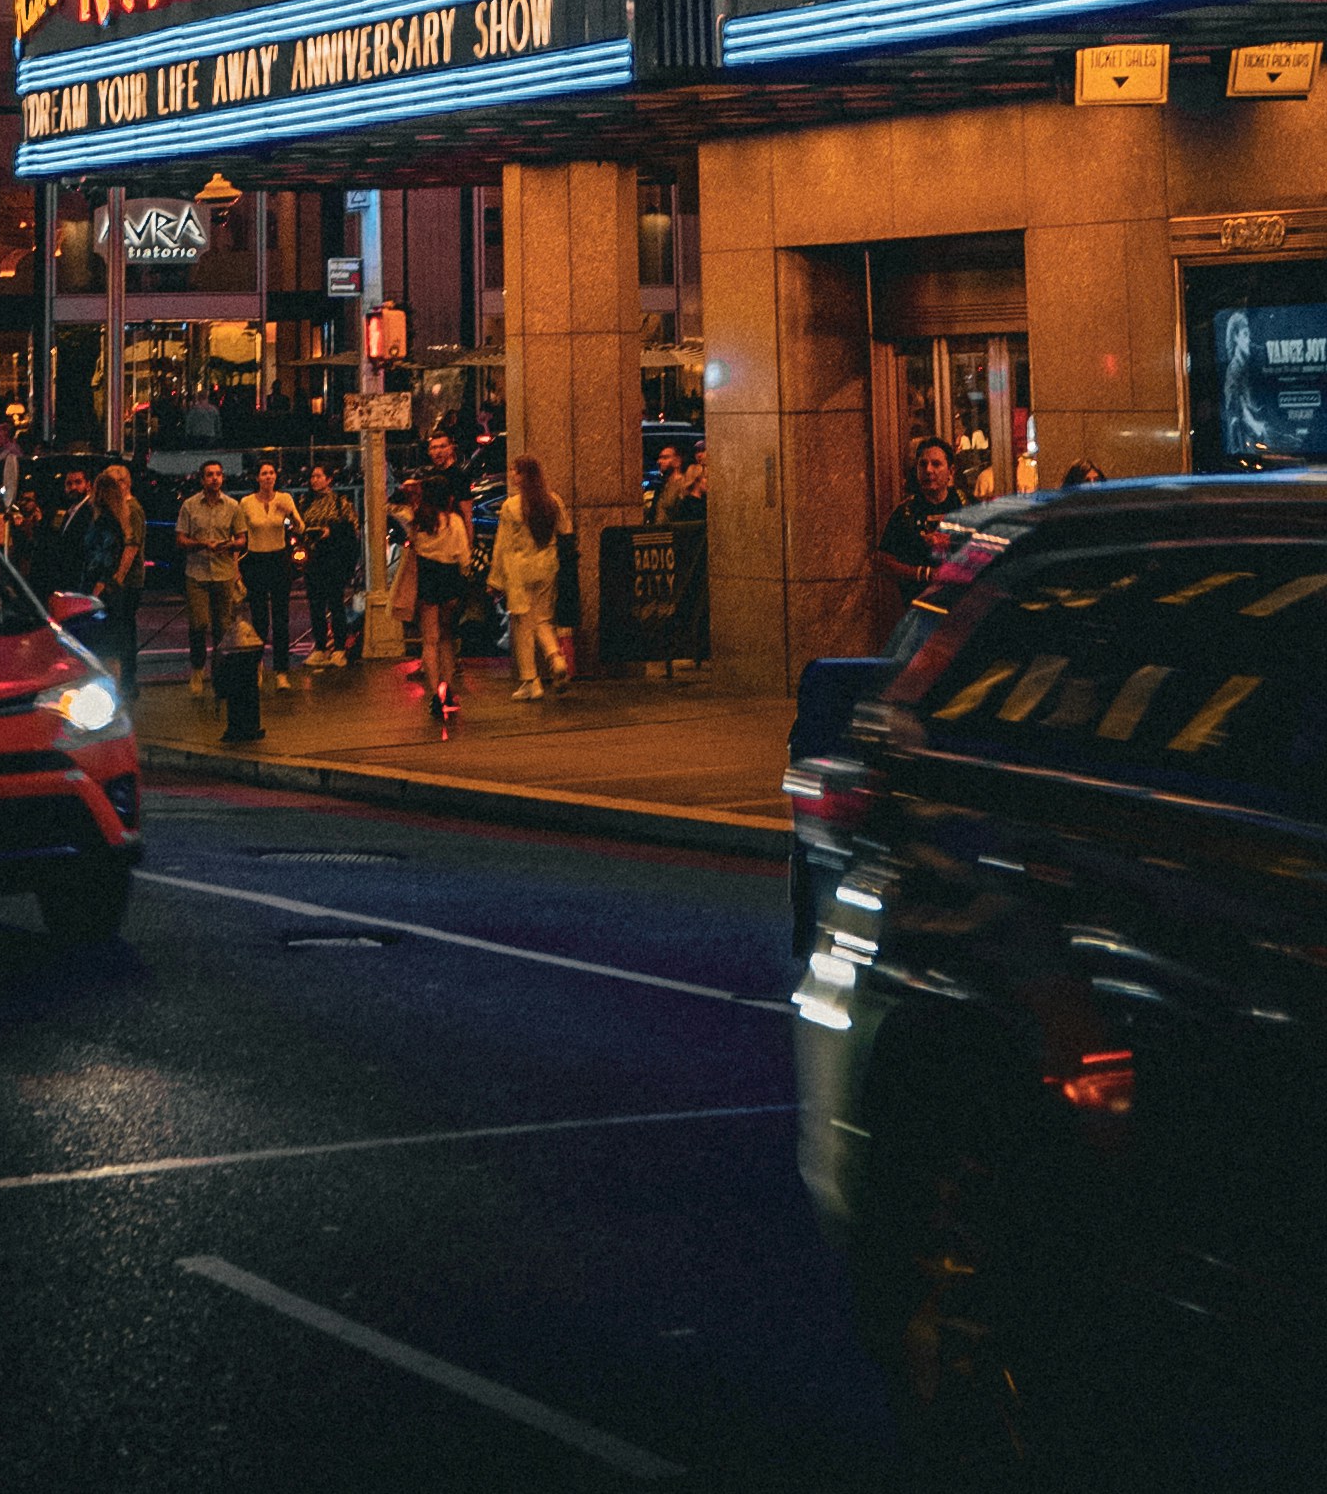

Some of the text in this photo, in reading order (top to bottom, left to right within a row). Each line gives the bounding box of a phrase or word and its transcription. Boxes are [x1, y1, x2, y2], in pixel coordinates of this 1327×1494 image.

[96, 71, 148, 125] YOUR
[157, 57, 200, 115] LIFE
[290, 9, 456, 92] ANNIVERSARY
[1125, 48, 1157, 68] SALES
[634, 547, 676, 571] RADIO
[634, 573, 676, 598] CITY
